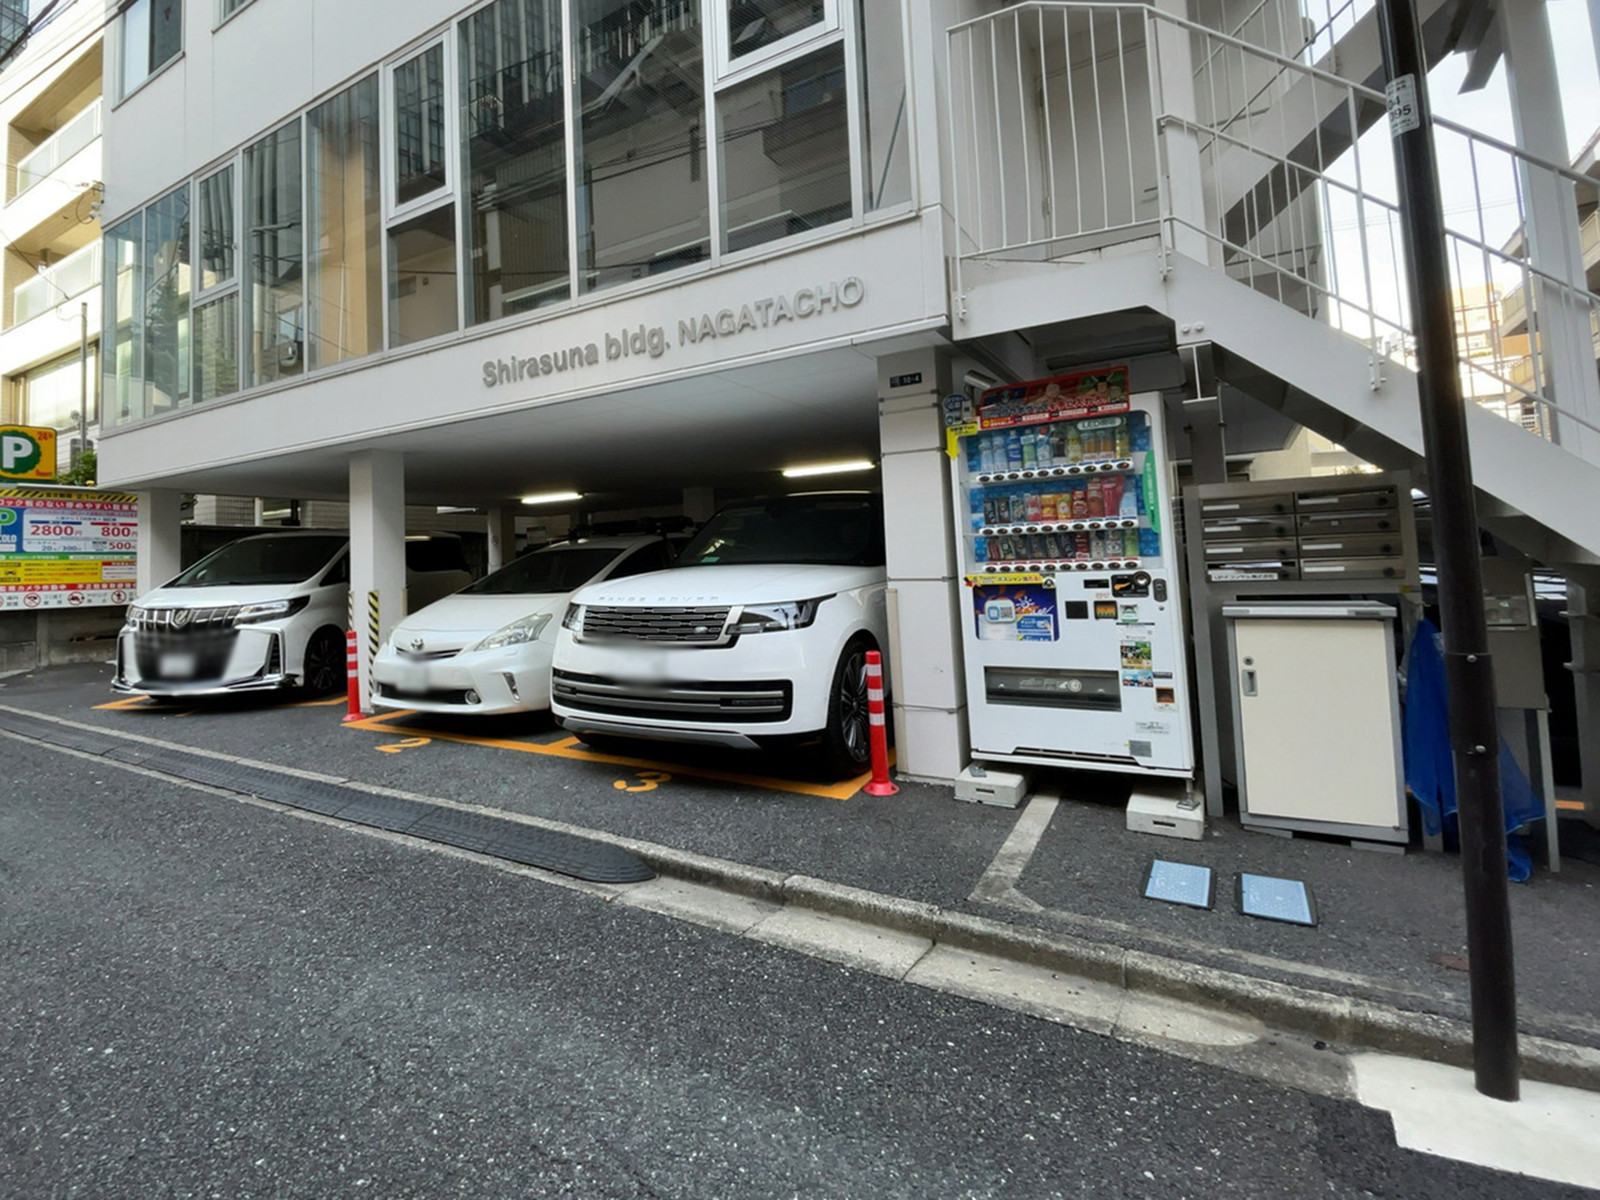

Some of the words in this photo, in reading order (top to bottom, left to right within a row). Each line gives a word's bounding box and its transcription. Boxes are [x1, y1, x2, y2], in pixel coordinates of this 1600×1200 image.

[482, 342, 599, 388] Shirasuna
[604, 323, 671, 359] bldg.
[677, 276, 865, 347] NAGATACHO
[2, 435, 34, 469] P
[375, 737, 432, 754] 2
[612, 771, 672, 792] 3
